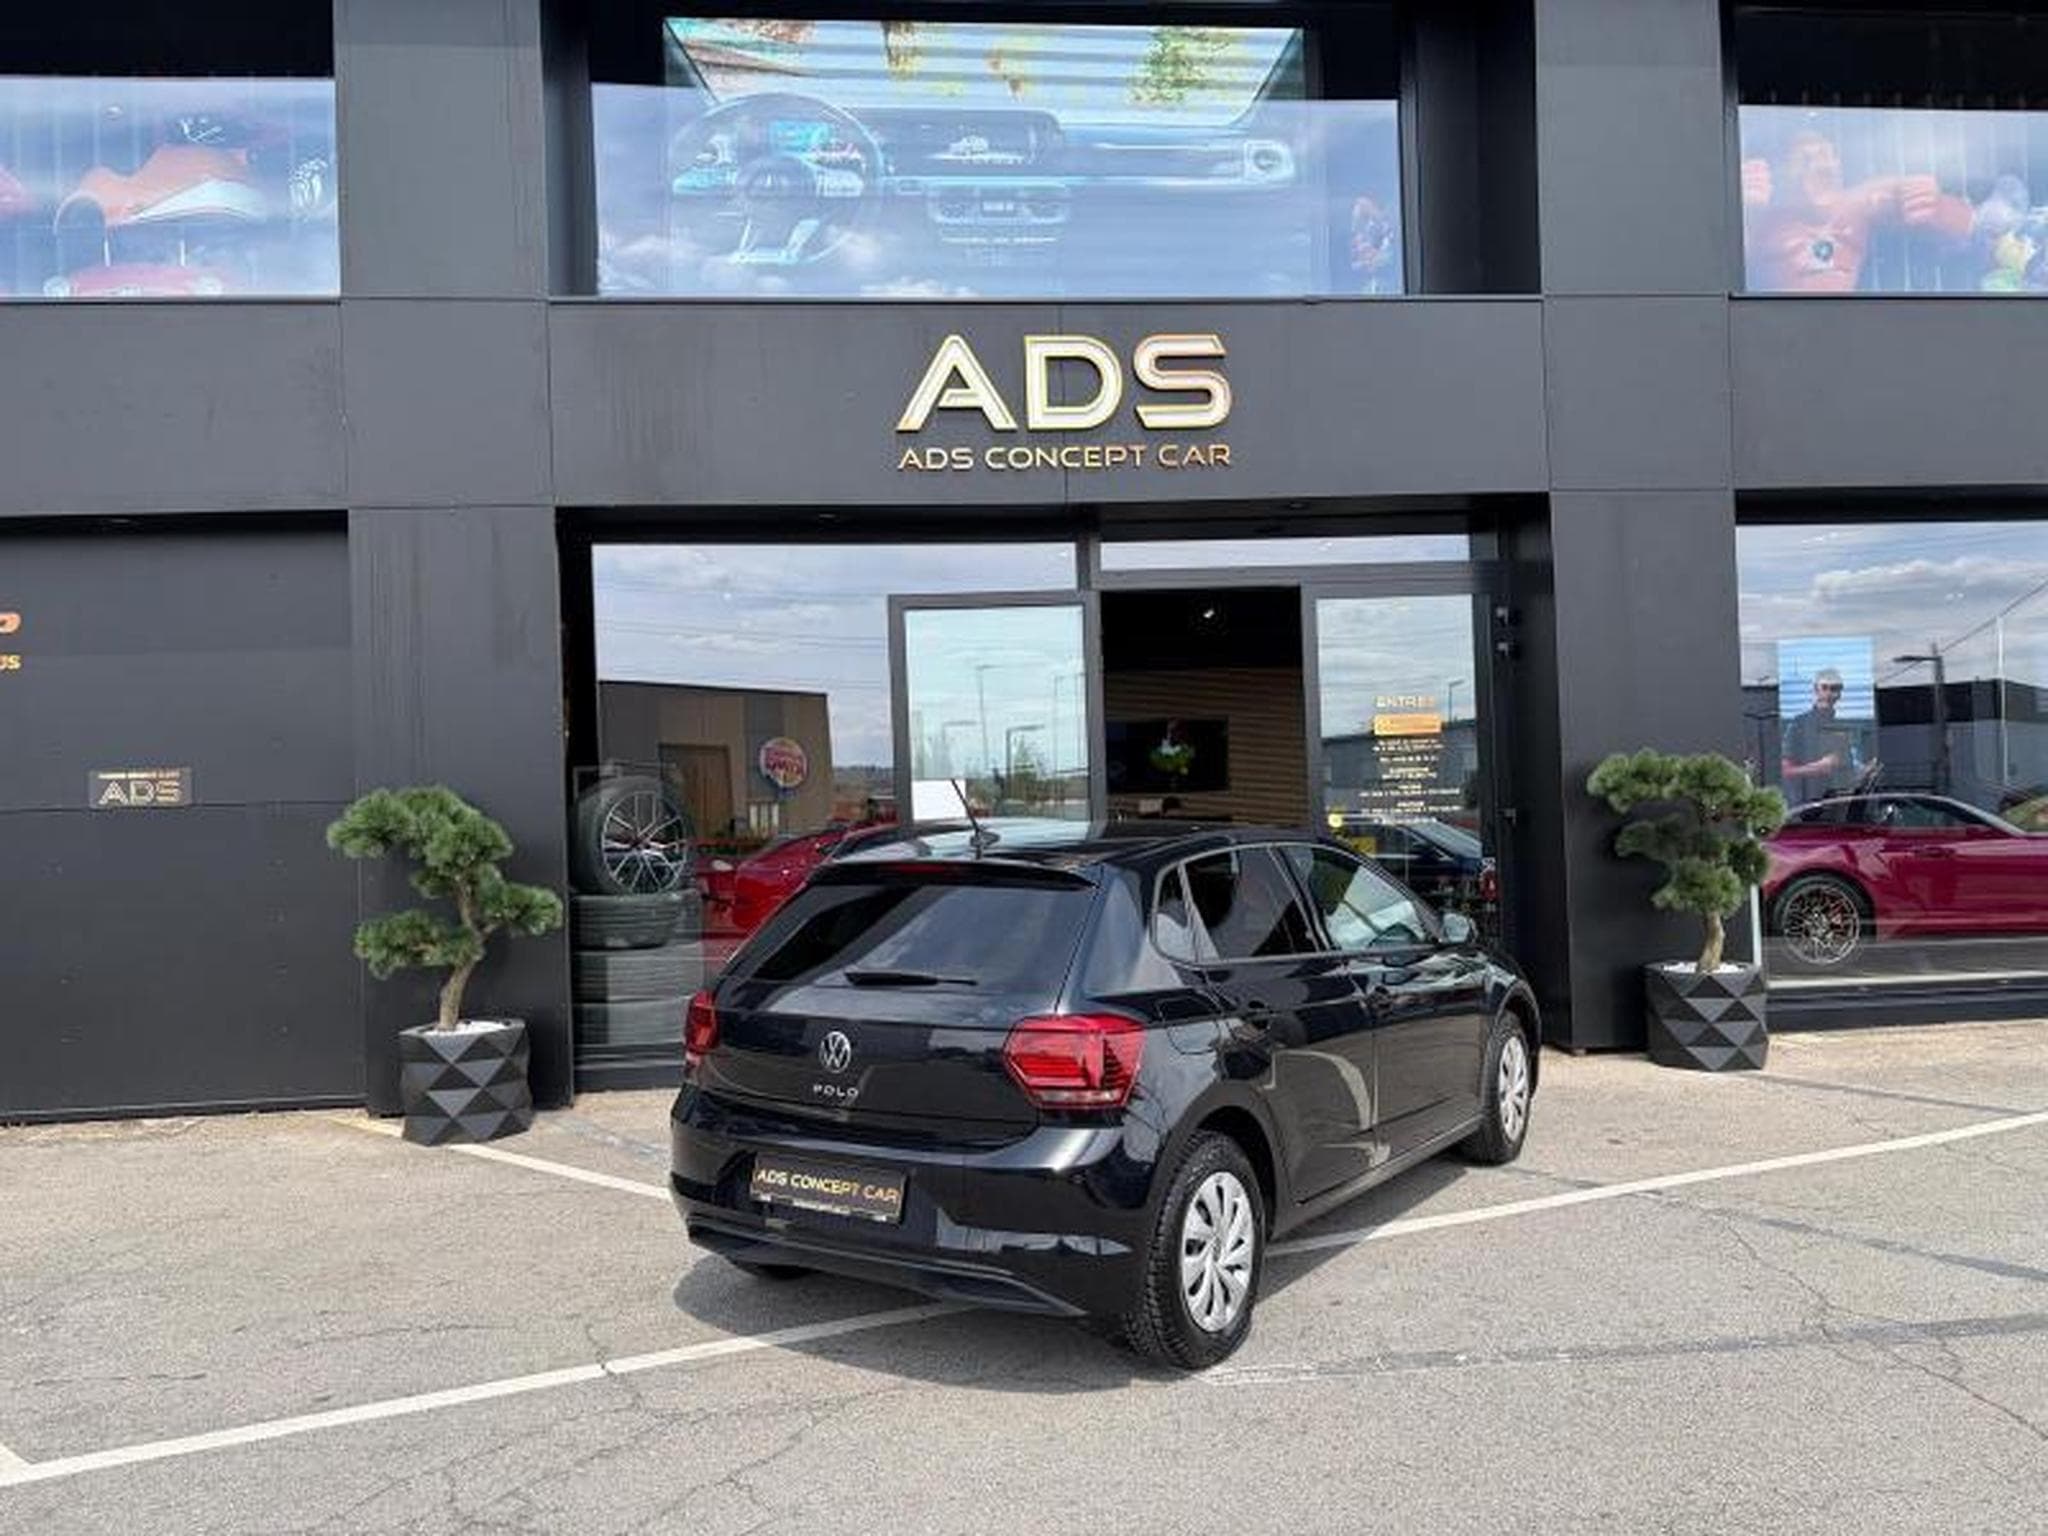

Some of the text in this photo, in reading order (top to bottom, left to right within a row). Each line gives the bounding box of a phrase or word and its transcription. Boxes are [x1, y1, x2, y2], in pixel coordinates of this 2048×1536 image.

[896, 334, 1232, 430] ADS
[897, 444, 1231, 470] ADS CONCEPT CAR
[98, 780, 182, 805] ADS
[813, 1084, 859, 1097] POLO
[757, 1169, 900, 1204] ADS CONCEPT CAR
